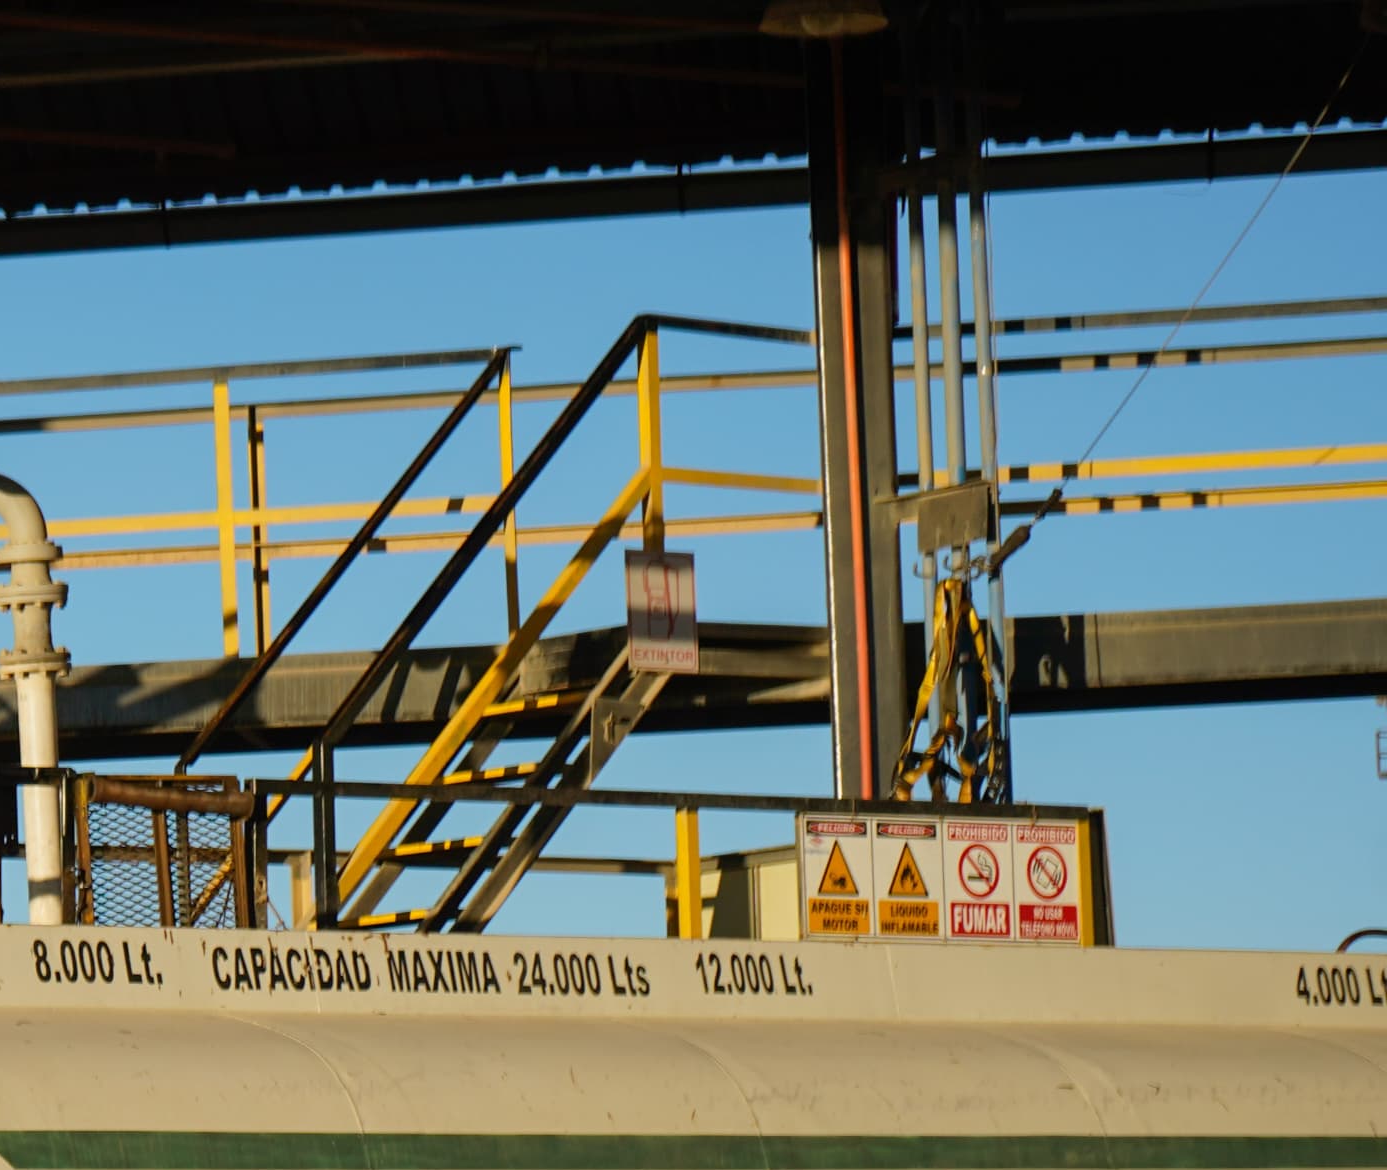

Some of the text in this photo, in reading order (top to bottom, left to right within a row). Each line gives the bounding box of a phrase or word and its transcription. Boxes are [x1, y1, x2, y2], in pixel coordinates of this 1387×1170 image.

[634, 647, 694, 662] EXTINTOR
[949, 826, 1007, 840] PROHIBIDO
[1018, 828, 1075, 843] PROHIBIDO
[811, 901, 852, 915] APAGUE
[822, 918, 859, 932] MOTOR
[953, 904, 1007, 934] FUMAR
[880, 921, 939, 935] INFLAMABLE
[32, 939, 164, 986] 8.000 Lt.
[211, 945, 651, 997] CAPACIDAD MAXIMA 24.000 Lts
[695, 951, 814, 997] 12.000 Lt.
[1296, 965, 1361, 1007] 4.000
